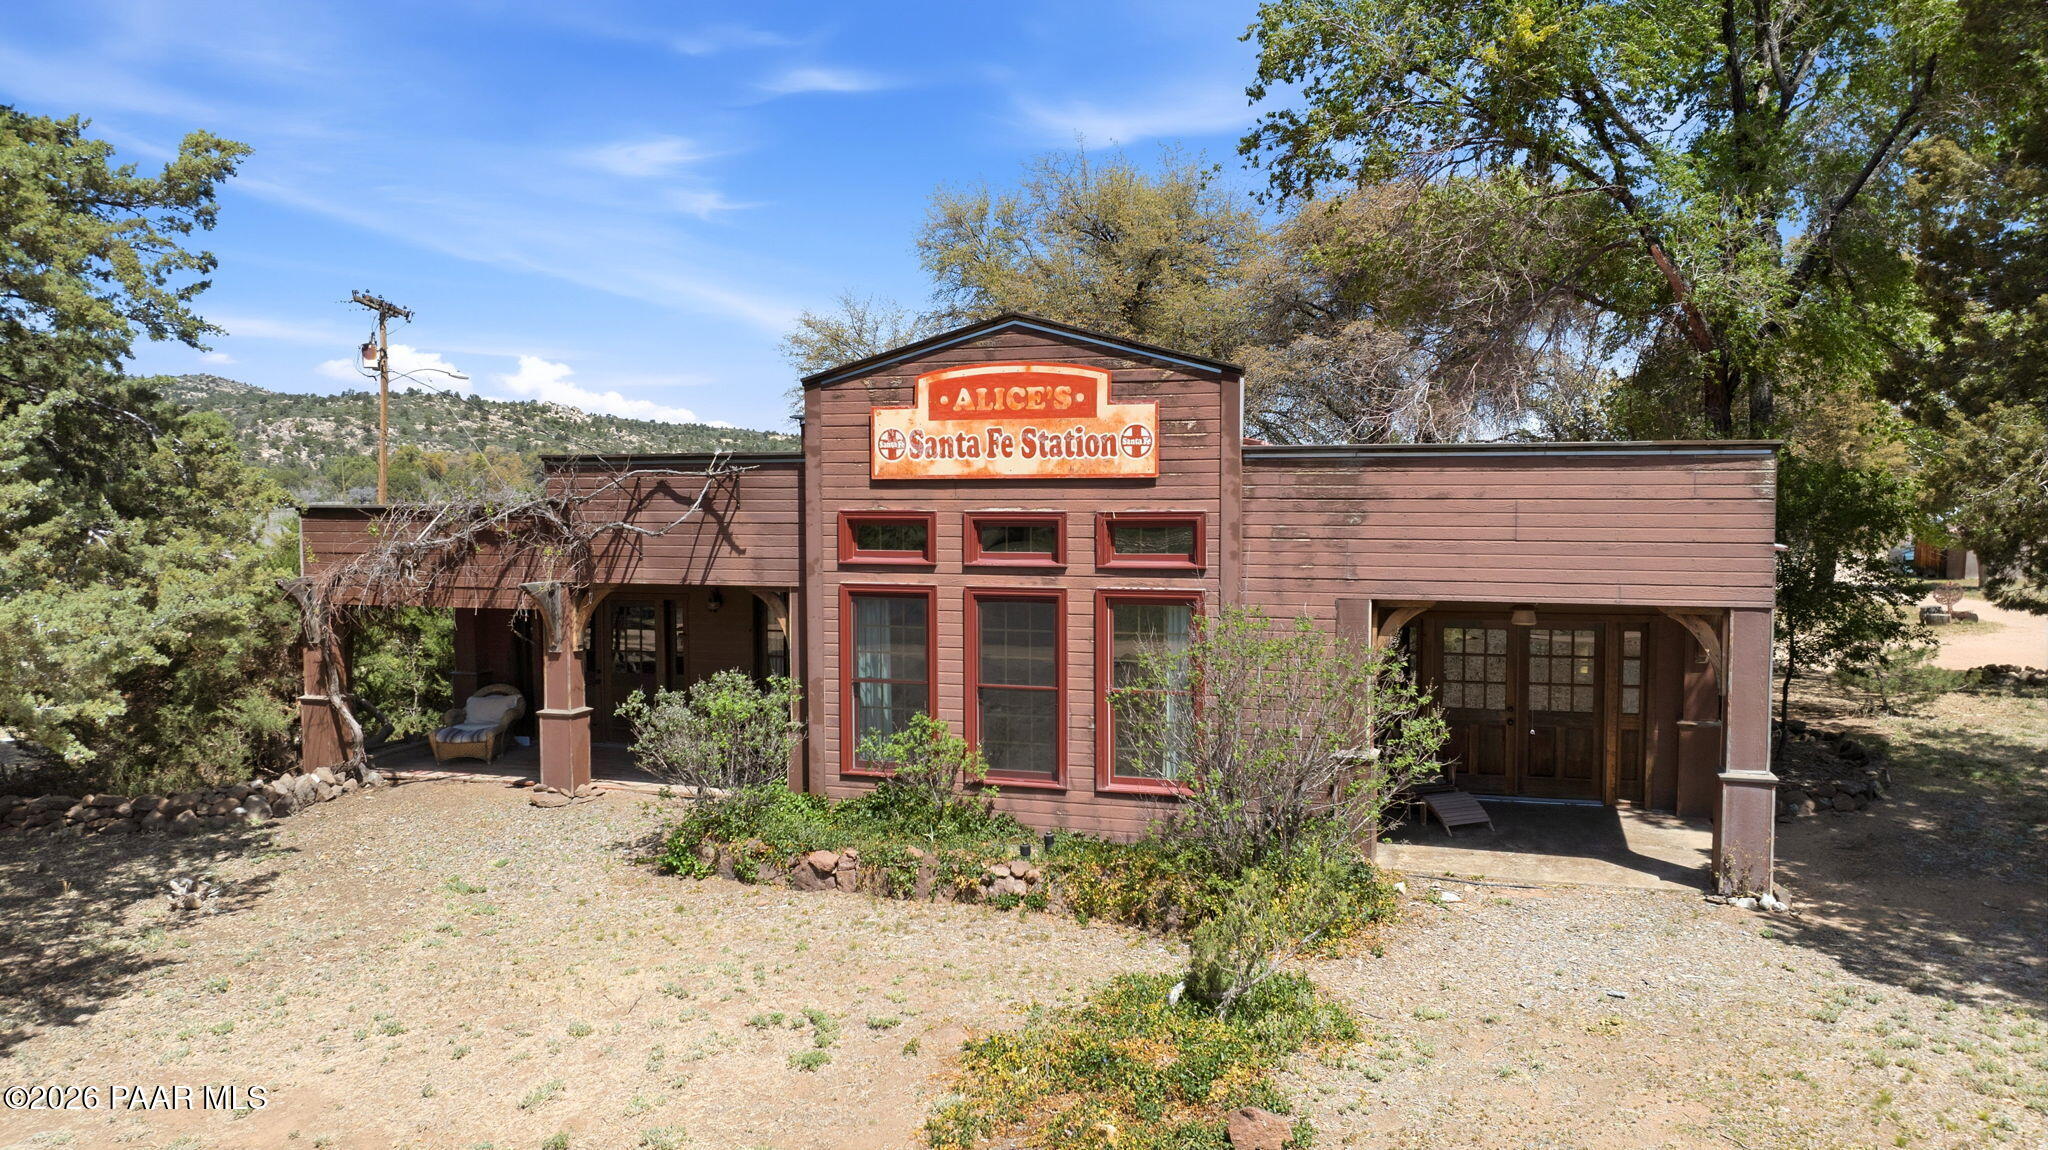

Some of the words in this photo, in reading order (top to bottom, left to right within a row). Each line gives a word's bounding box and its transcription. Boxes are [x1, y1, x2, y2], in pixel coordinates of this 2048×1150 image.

[953, 386, 1072, 411] ALICE'S
[909, 429, 981, 459] Santa
[987, 428, 1014, 458] Fe
[1021, 426, 1118, 459] Station
